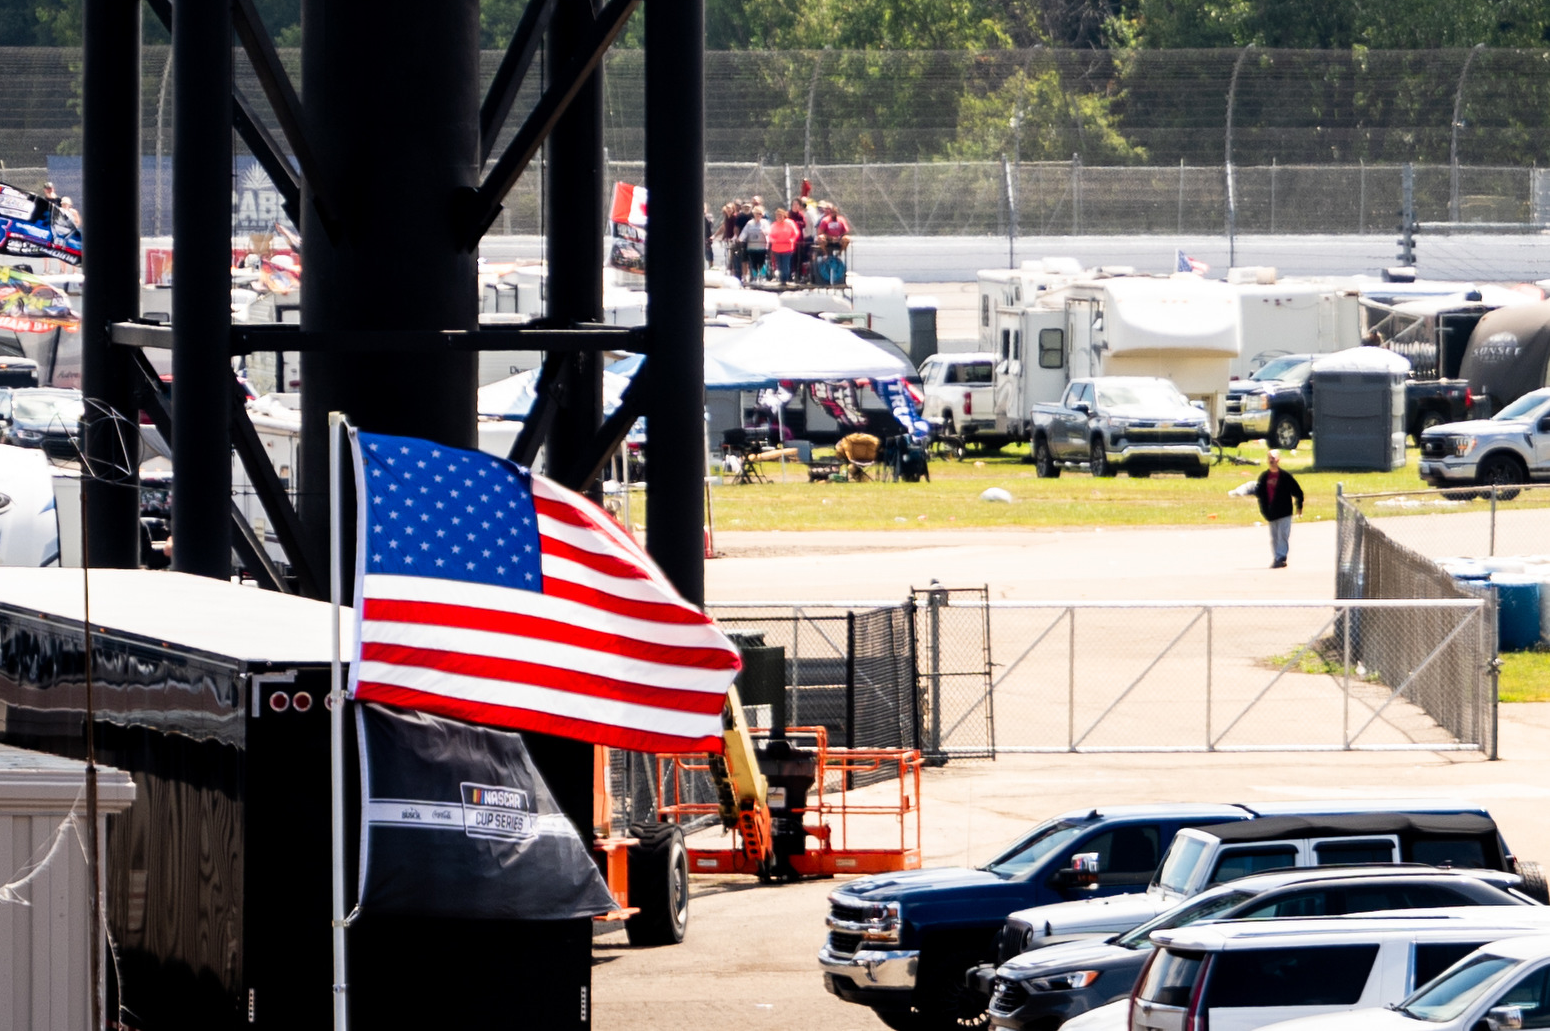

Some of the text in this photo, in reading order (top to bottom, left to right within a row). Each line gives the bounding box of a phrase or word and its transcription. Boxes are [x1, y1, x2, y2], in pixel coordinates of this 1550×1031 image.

[232, 190, 293, 228] AB
[1473, 346, 1523, 357] SUNSET
[484, 789, 521, 809] NASCAR
[476, 811, 524, 831] CUP SERIES
